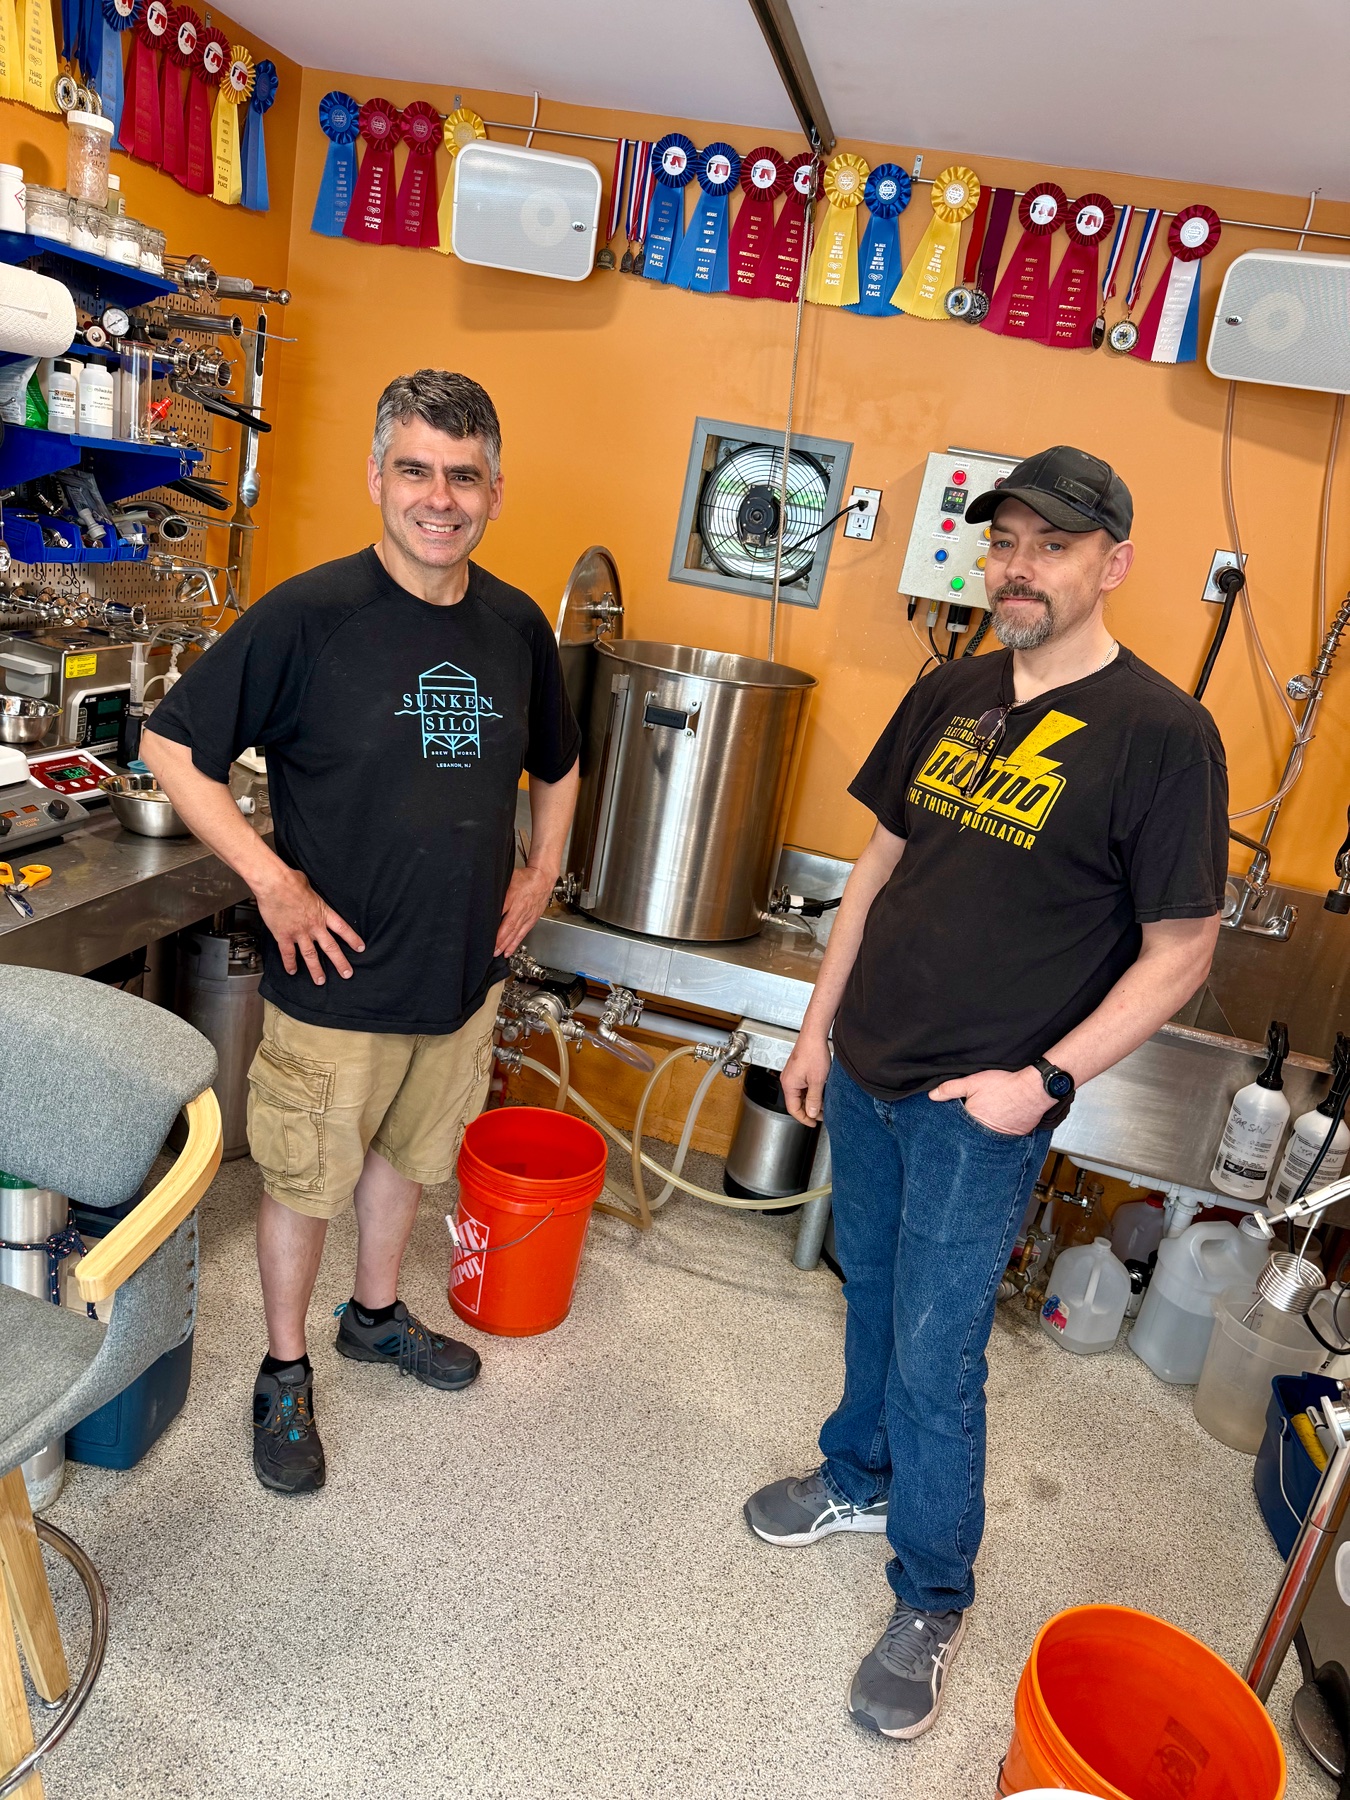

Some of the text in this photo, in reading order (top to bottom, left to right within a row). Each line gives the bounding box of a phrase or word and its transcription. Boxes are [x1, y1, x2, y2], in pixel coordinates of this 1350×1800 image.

[29, 69, 42, 80] THIRD
[28, 76, 42, 88] PLACE
[218, 173, 229, 182] THIRD
[217, 180, 228, 189] PLACE
[364, 215, 381, 224] SECOND
[364, 222, 379, 230] PLACE
[737, 269, 755, 278] SECOND
[775, 273, 793, 282] SECOND
[775, 280, 790, 289] PLACE
[921, 283, 936, 292] THIRD
[919, 290, 934, 300] PLACE
[1009, 309, 1029, 317] SECOND
[1008, 319, 1025, 327] PLACE
[1056, 320, 1076, 328] SECOND
[1055, 330, 1072, 338] PLACE
[402, 693, 493, 711] SUNKEN
[425, 716, 475, 731] SILO
[950, 715, 966, 726] IT'S
[907, 787, 1036, 851] THE THIRST MUTILATOR
[1231, 1113, 1271, 1135] STAR SAN
